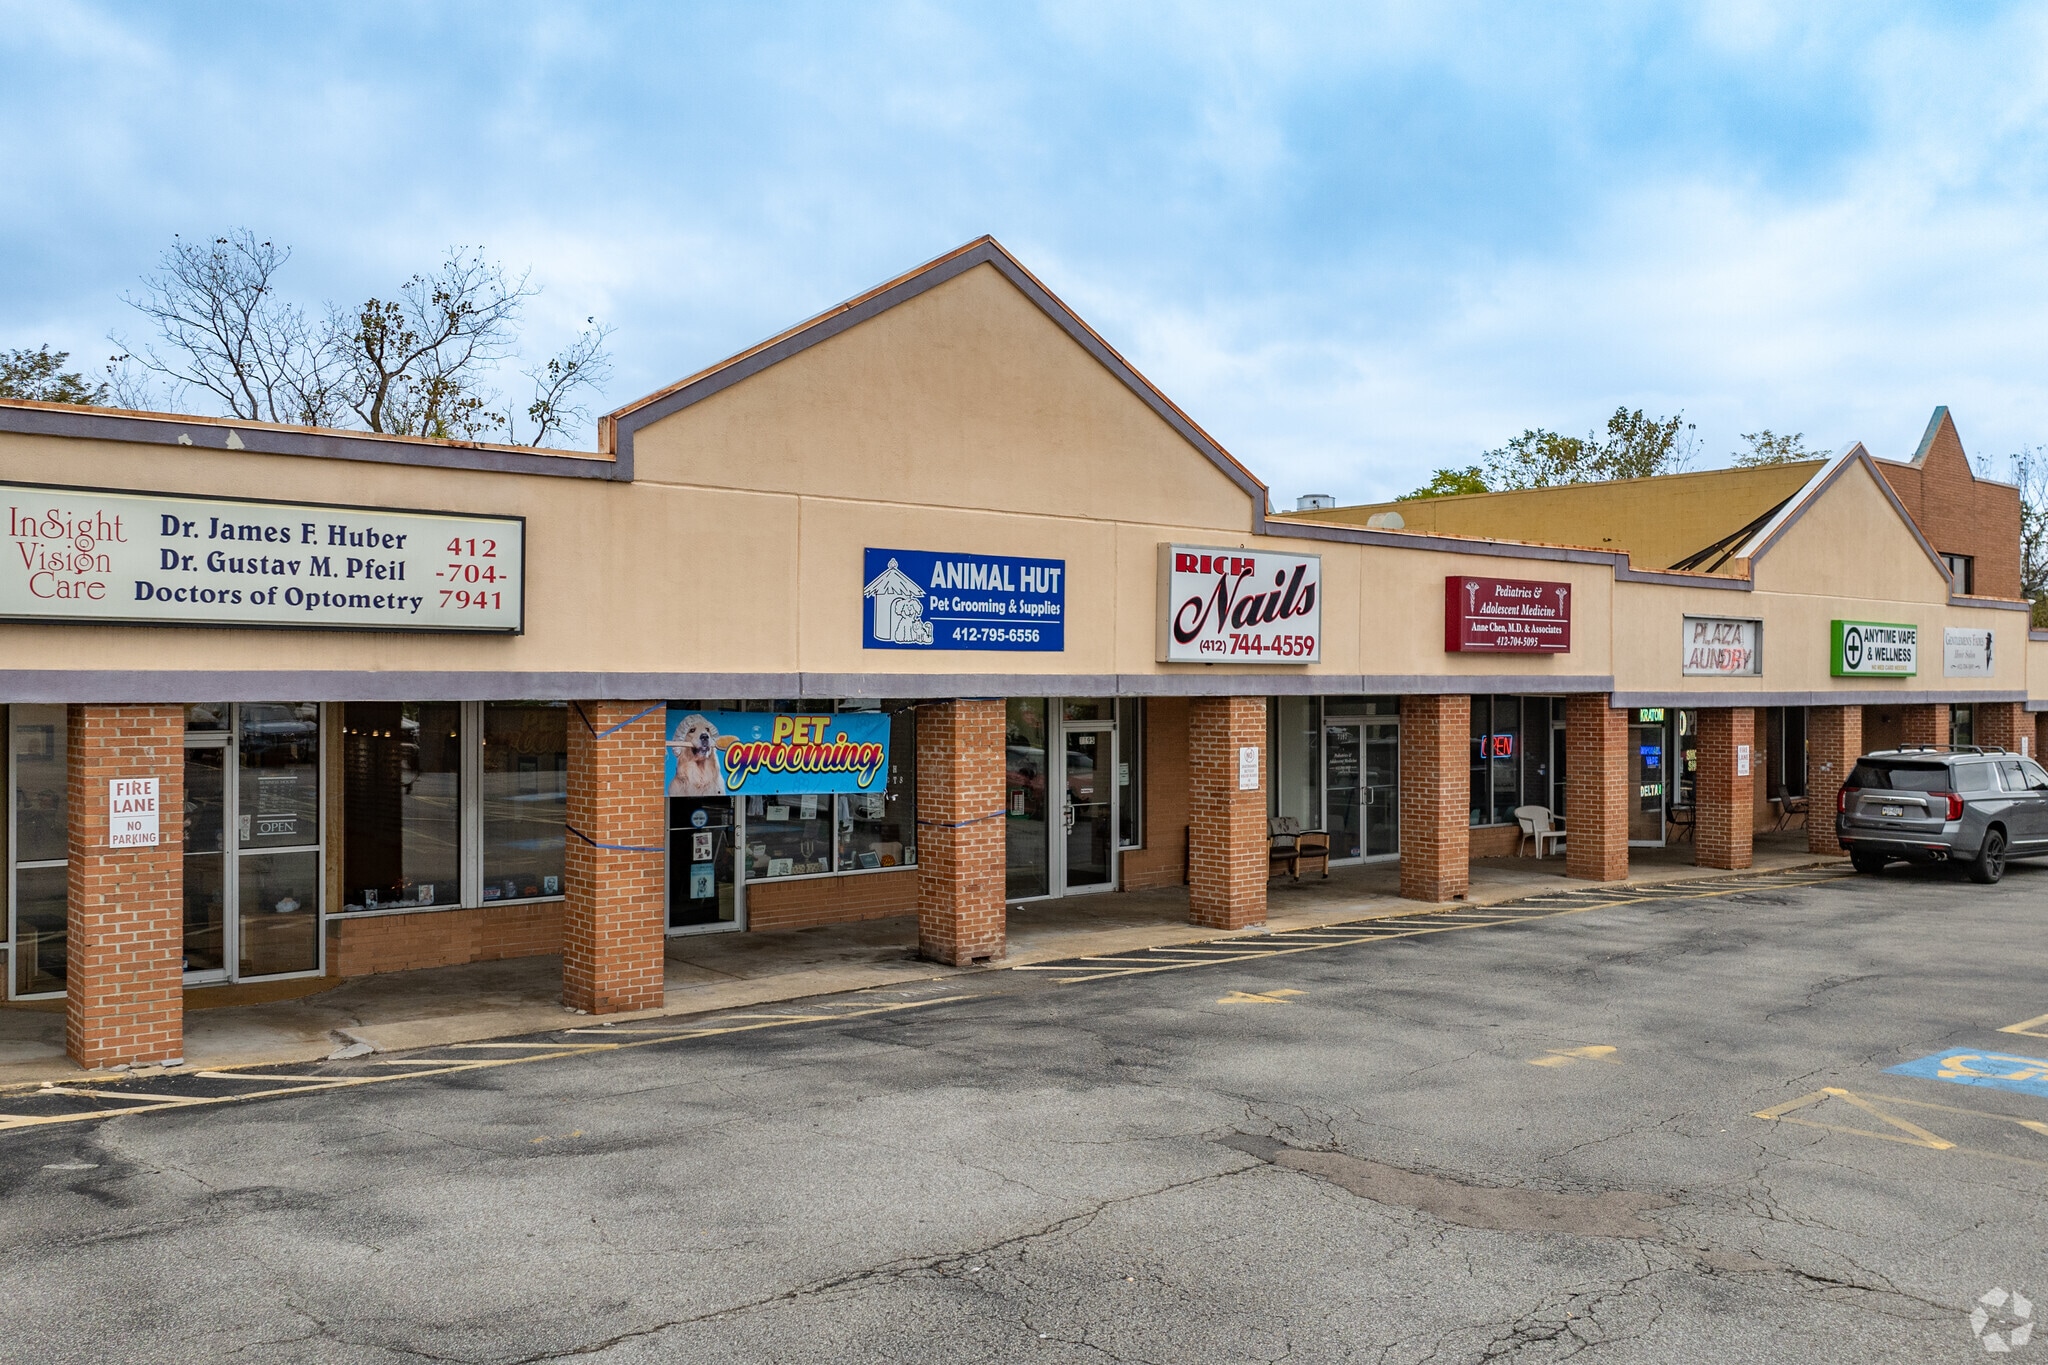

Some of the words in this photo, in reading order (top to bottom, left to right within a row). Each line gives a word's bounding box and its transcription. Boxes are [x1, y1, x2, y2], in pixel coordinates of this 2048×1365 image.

[8, 506, 128, 549] InSight
[160, 514, 199, 538] Dr.
[208, 517, 291, 543] James
[301, 523, 317, 545] F.
[328, 524, 407, 549] Huber
[16, 541, 112, 574] Vision
[447, 537, 497, 558] 412
[160, 548, 198, 572] Dr.
[207, 551, 301, 575] Gustav
[309, 556, 338, 578] M.
[346, 557, 405, 580] Pfeil
[436, 563, 507, 583] -704-
[1175, 553, 1255, 577] RICH
[30, 571, 106, 600] Care
[930, 561, 1015, 591] ANIMAL
[1020, 566, 1061, 593] HUT
[134, 581, 242, 604] Doctors
[250, 586, 278, 605] of
[284, 587, 424, 614] Optometry
[439, 590, 501, 609] 7941
[1495, 585, 1532, 598] Pediatrics
[1534, 587, 1543, 599] &
[930, 596, 949, 612] Pet
[952, 597, 1006, 616] Grooming
[1009, 601, 1017, 614] &
[1019, 600, 1061, 617] Supplies
[1173, 564, 1316, 645] Nails
[1480, 602, 1519, 616] Adolescent
[1521, 604, 1555, 617] Medicine
[952, 627, 1040, 643] 412-795-6556
[1471, 622, 1488, 632] Anne
[1489, 622, 1507, 634] Chen,
[1508, 623, 1524, 633] M.D.
[1524, 625, 1531, 633] &
[1531, 625, 1562, 634] Associates
[1693, 622, 1745, 645] PLAZA
[1864, 628, 1896, 644] ANYTIME
[1898, 630, 1916, 645] VAPE
[1199, 640, 1227, 654] (412)
[1229, 633, 1315, 656] 744-4559
[1497, 636, 1538, 647] 412-704-5095
[1867, 647, 1873, 661] &
[1875, 647, 1912, 662] WELLNESS
[772, 716, 831, 746] PET
[725, 733, 884, 789] grooming
[117, 782, 151, 796] FIRE
[113, 798, 155, 813] LANE
[127, 821, 142, 831] NO
[260, 822, 294, 833] OPEN
[112, 832, 156, 845] PARKING
